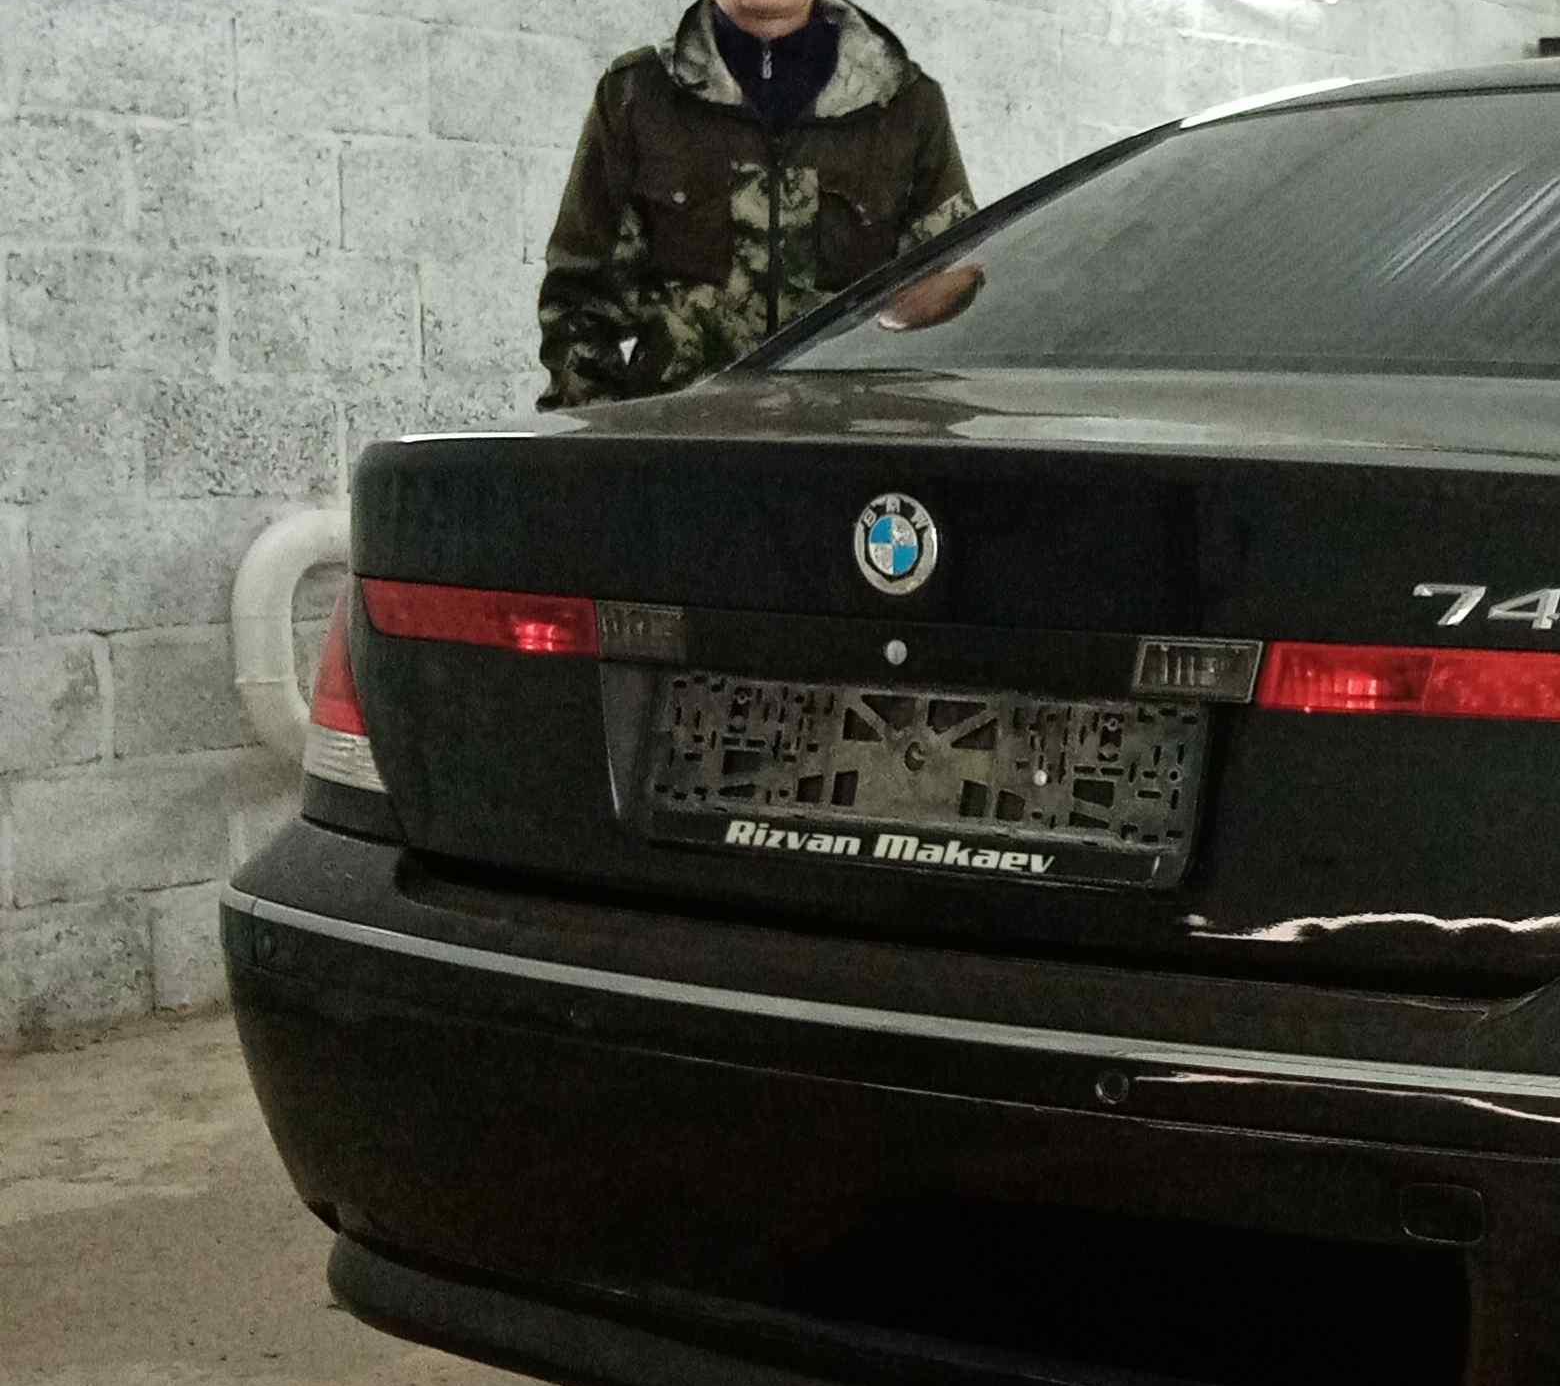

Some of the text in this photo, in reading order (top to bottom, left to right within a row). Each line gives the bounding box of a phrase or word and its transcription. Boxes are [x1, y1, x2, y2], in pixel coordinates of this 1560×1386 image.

[863, 495, 930, 530] BMW
[724, 819, 1056, 874] Rizvan Makaev
